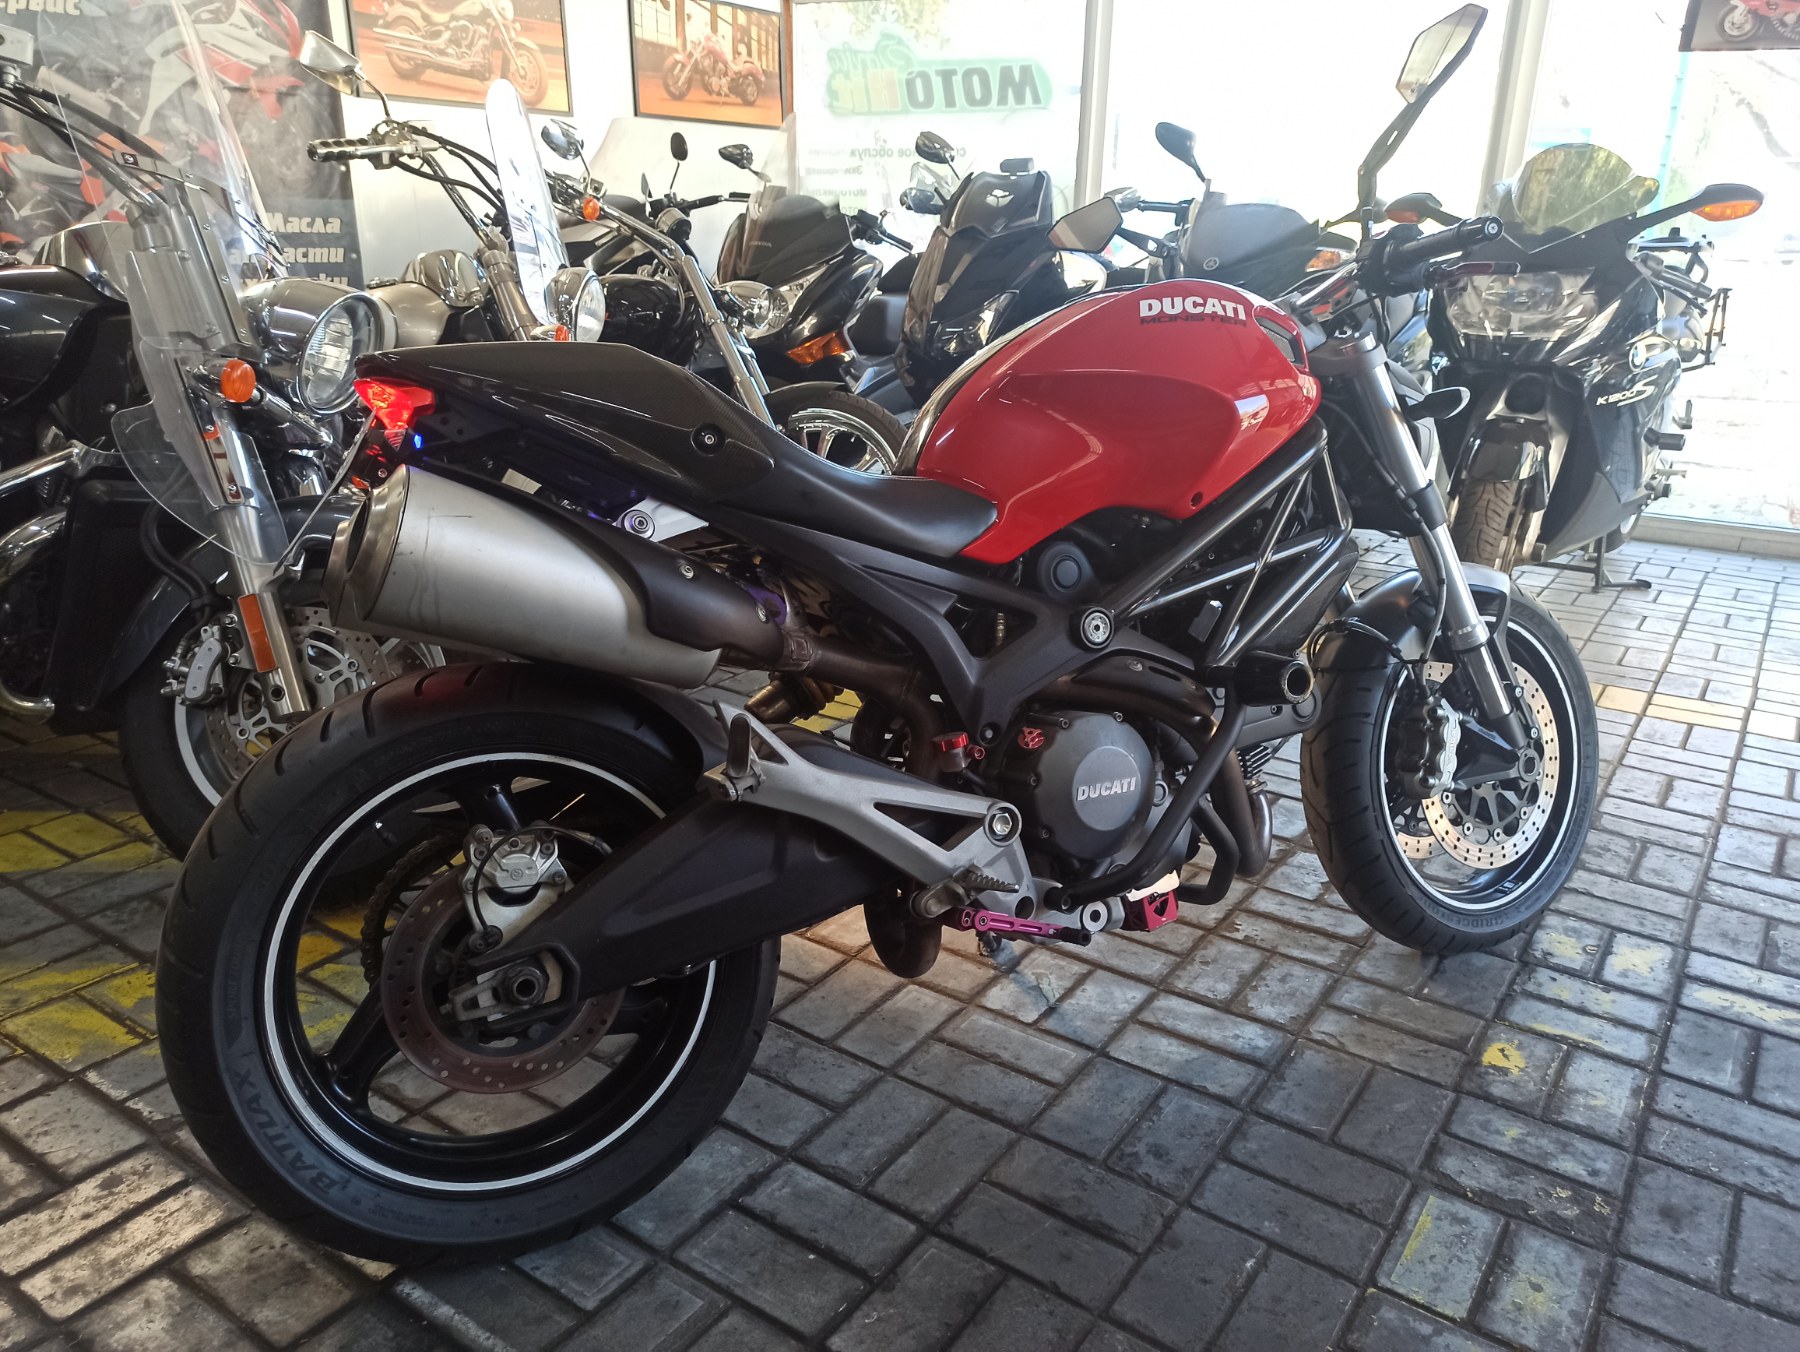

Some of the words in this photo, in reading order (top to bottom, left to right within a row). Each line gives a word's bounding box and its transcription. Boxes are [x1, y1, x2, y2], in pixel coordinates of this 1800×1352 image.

[0, 0, 81, 15] рвис
[266, 212, 341, 233] Масла
[1139, 296, 1246, 320] DUCATI
[1076, 776, 1137, 801] DUCATI
[236, 1066, 339, 1195] BATTLAX
